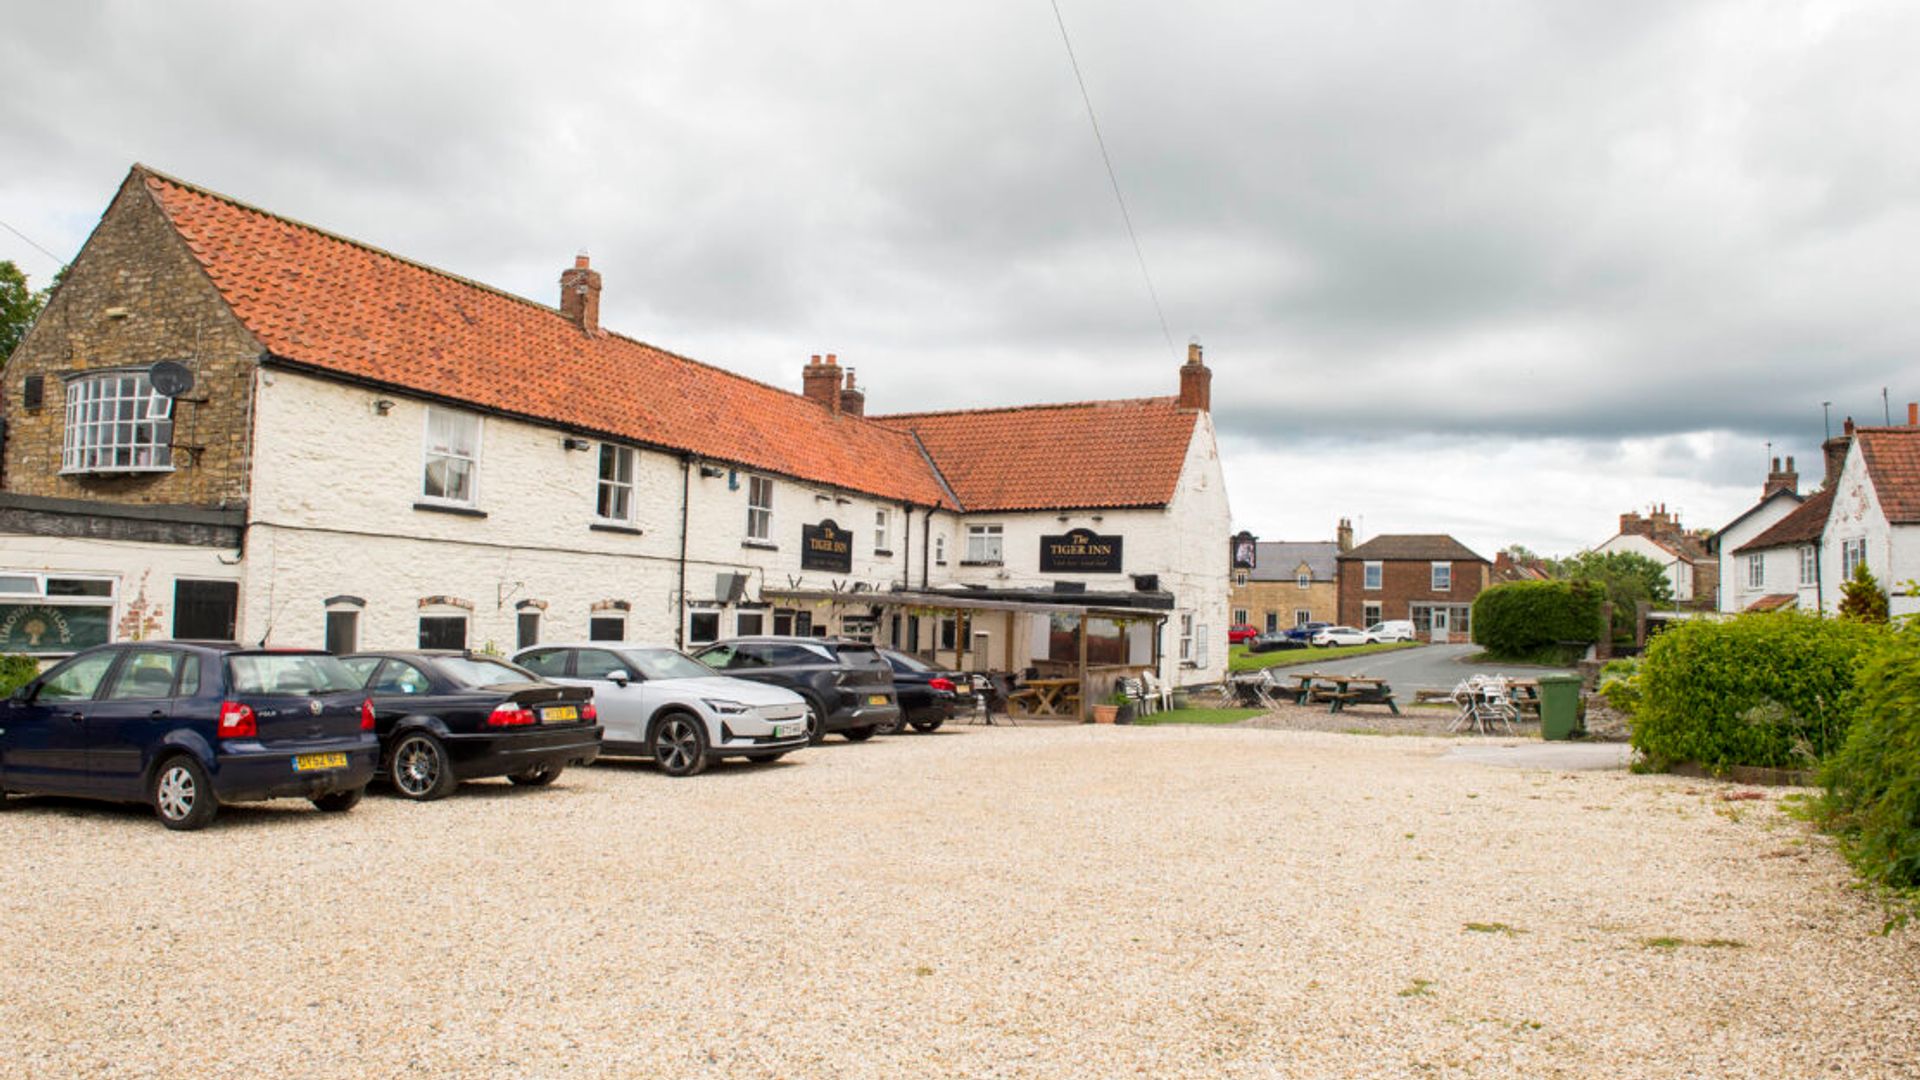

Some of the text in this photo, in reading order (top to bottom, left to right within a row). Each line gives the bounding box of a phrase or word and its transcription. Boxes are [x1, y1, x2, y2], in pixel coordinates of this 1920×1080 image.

[823, 527, 835, 539] The
[1072, 534, 1089, 544] The
[809, 538, 847, 553] TIGER INN
[1050, 544, 1112, 555] TIGER INN
